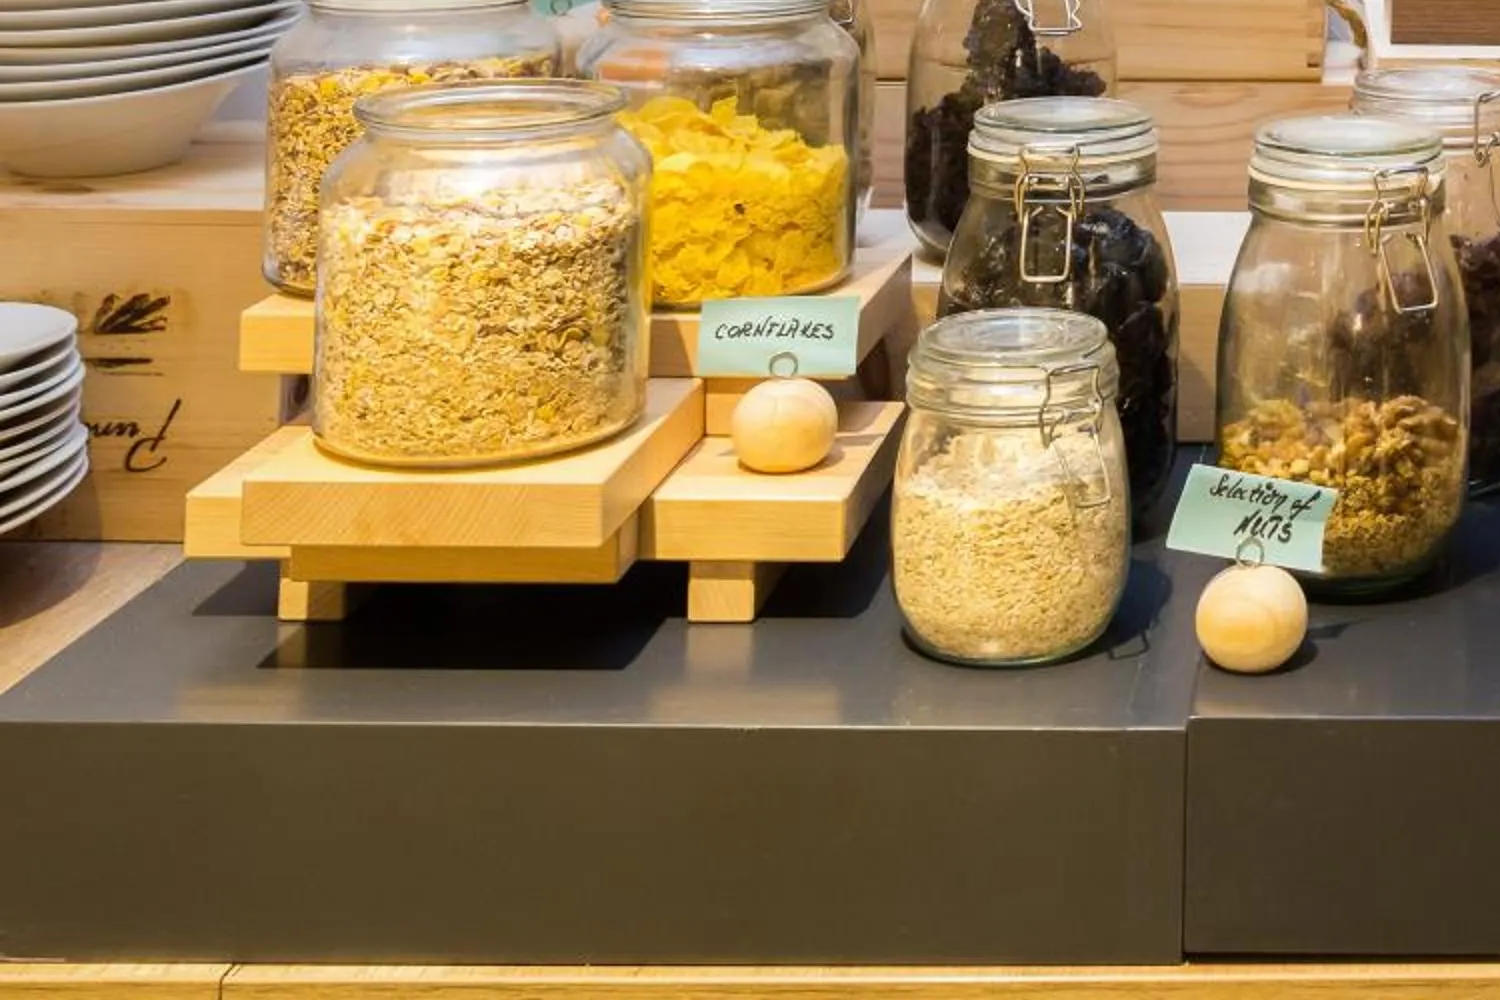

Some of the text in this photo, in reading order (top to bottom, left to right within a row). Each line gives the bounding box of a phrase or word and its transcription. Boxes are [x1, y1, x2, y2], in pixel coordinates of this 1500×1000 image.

[714, 315, 836, 341] CORNFLAKES
[1209, 473, 1323, 521] Selection of
[1232, 509, 1294, 544] NUTS
